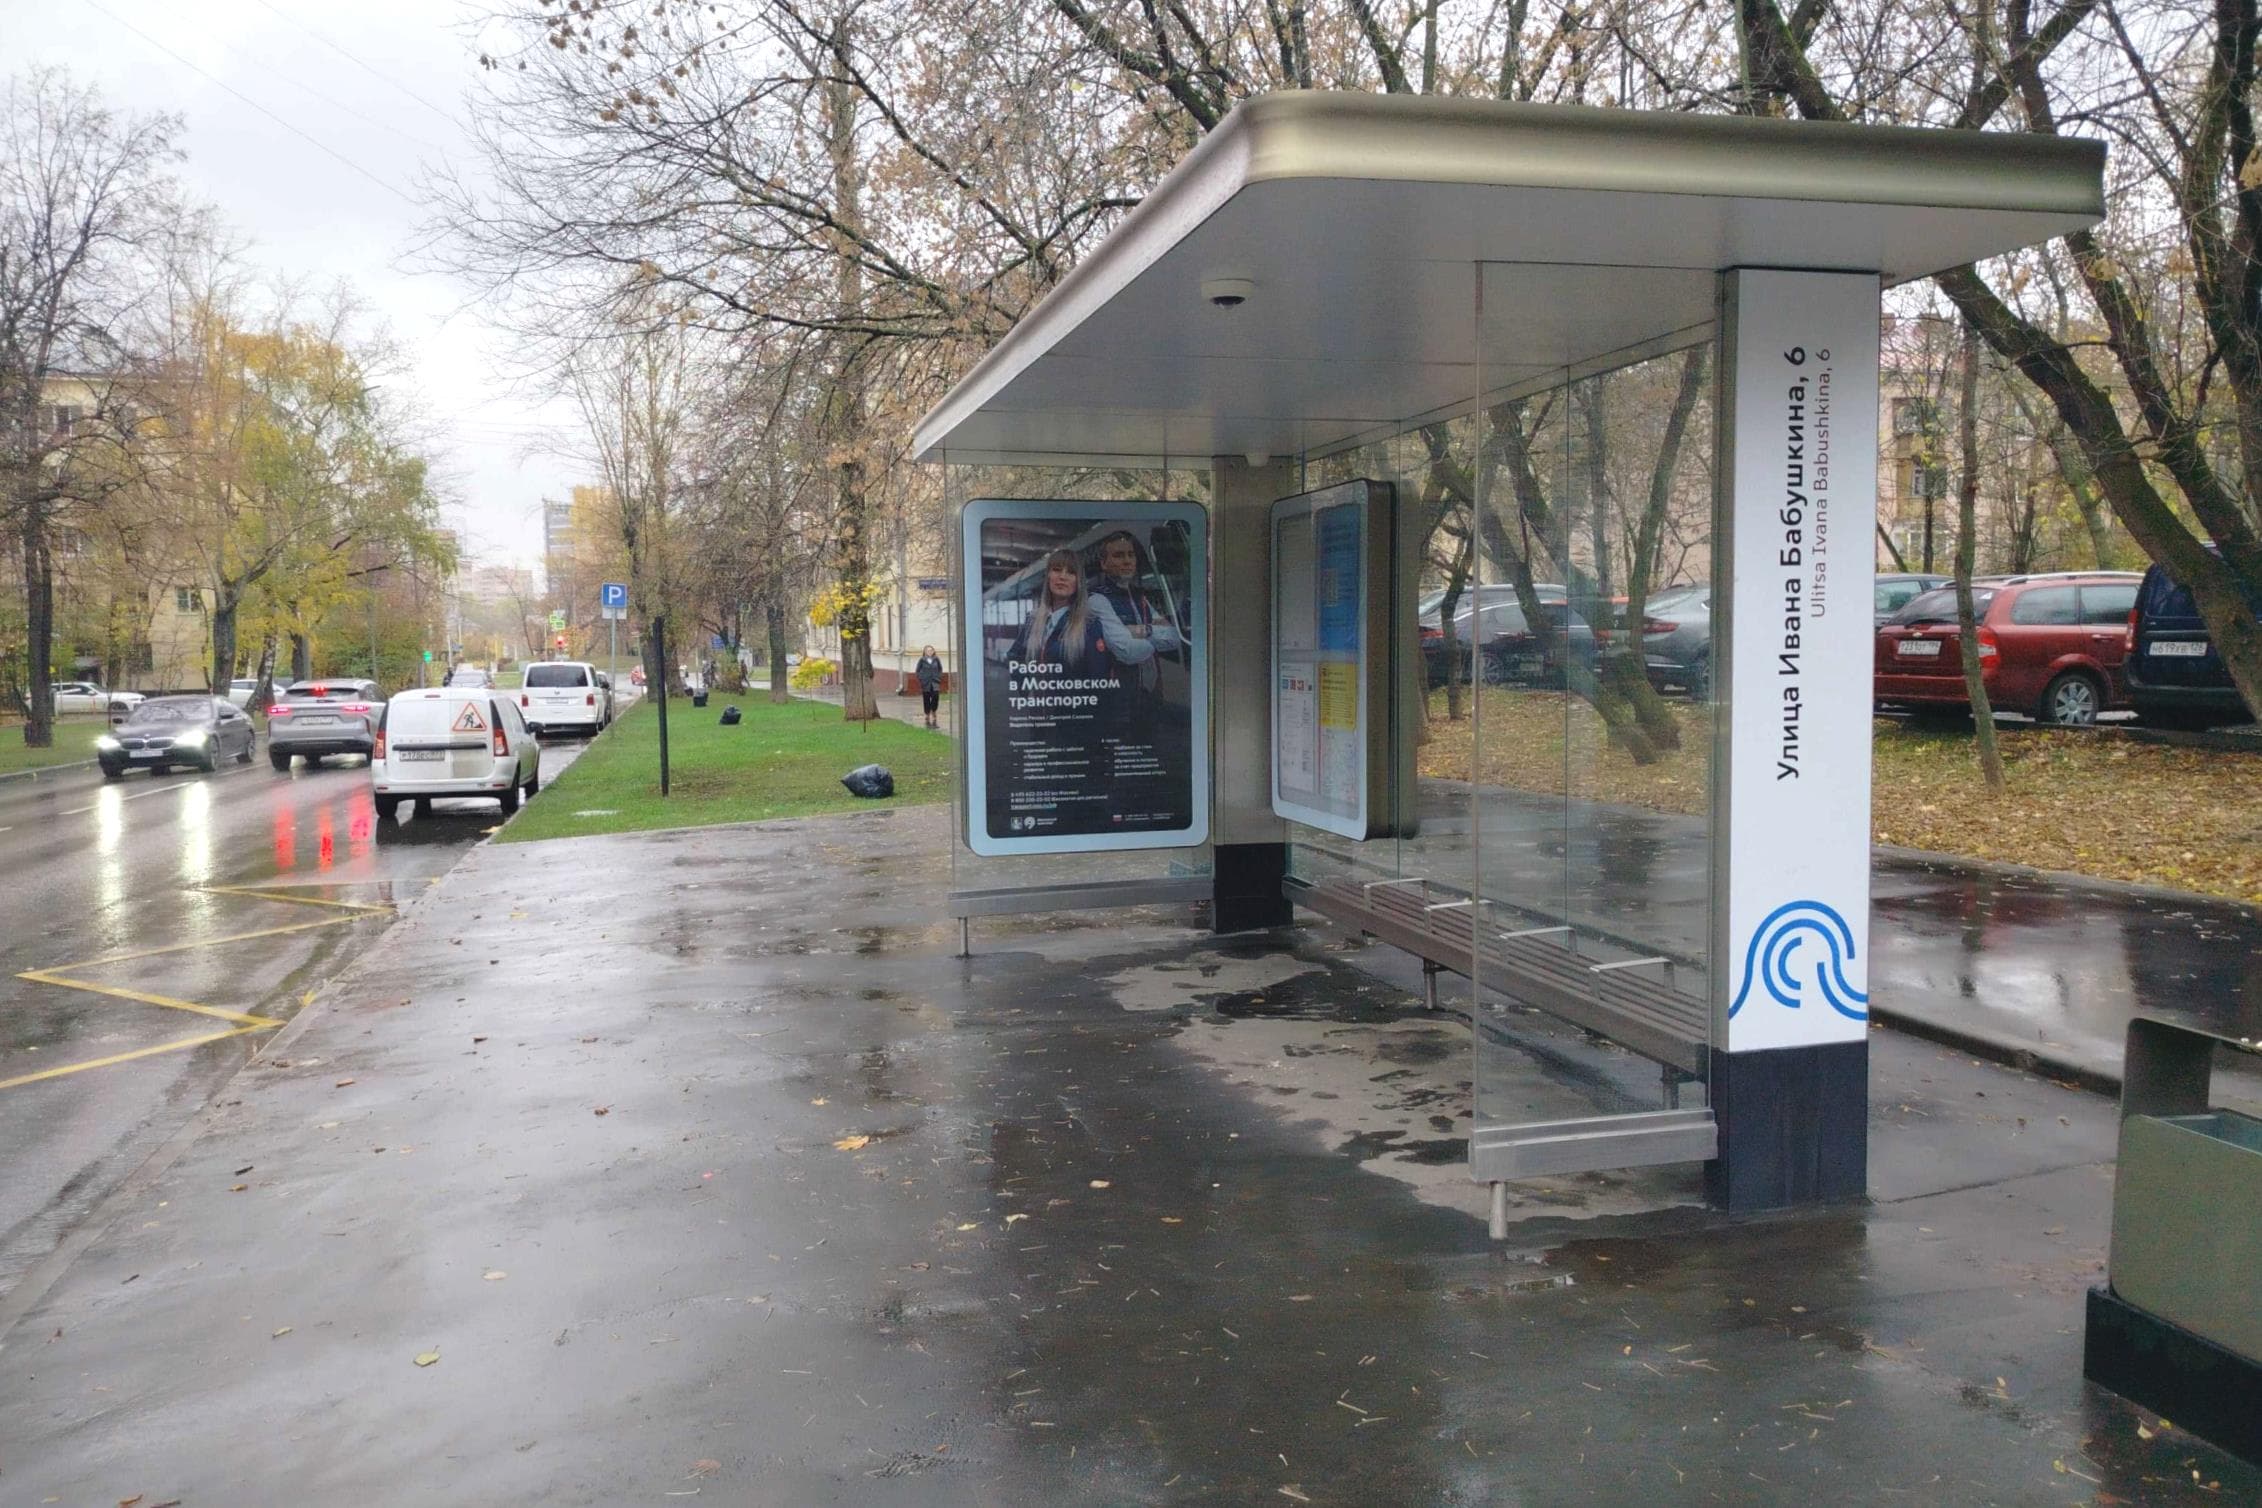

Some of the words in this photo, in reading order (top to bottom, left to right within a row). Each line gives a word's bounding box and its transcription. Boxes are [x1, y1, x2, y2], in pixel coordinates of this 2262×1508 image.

[1784, 346, 1806, 366] 6
[1815, 348, 1831, 361] 6
[1813, 367, 1832, 492] Babushkina,
[1779, 377, 1809, 566] Бабушкина,
[1812, 499, 1828, 555] Ivana
[1811, 562, 1826, 618] Ulitsa
[1779, 577, 1801, 675] Ивана
[1009, 660, 1063, 674] Работа
[1009, 680, 1018, 691] в
[1021, 676, 1120, 690] Московском
[1008, 695, 1098, 710] транспорте
[1777, 686, 1802, 781] Улица
